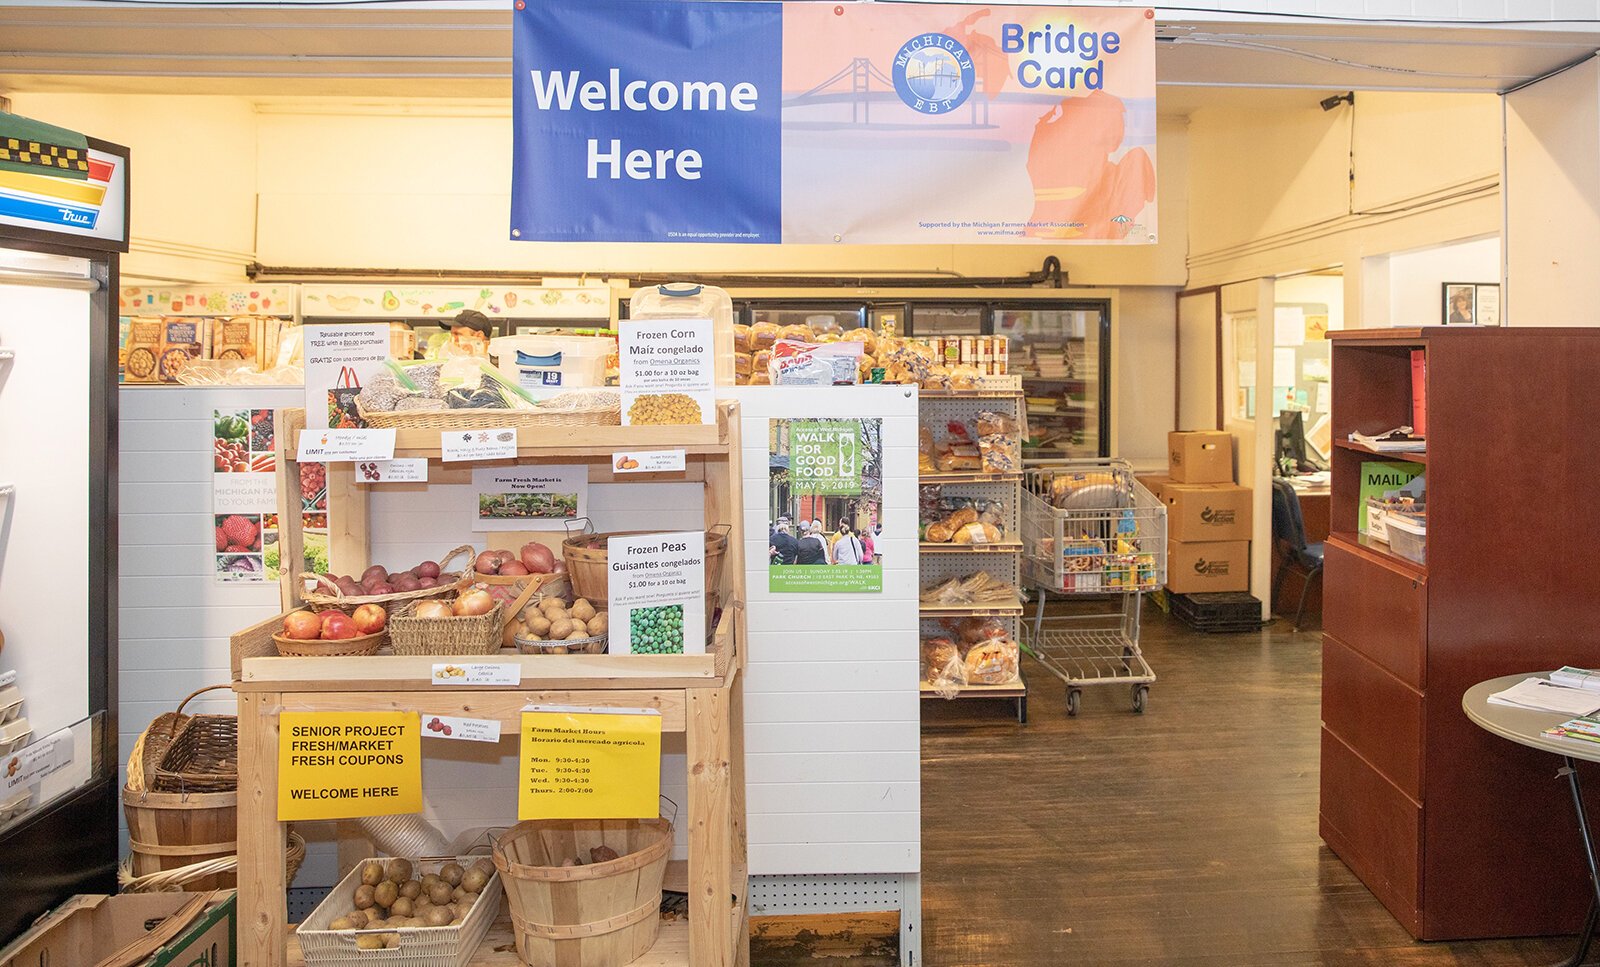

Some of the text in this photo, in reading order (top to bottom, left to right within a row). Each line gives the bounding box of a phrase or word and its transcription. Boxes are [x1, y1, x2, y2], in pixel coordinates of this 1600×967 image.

[1001, 23, 1121, 61] Bridge
[895, 34, 972, 71] MICHIGAN
[1017, 59, 1104, 91] Card
[531, 68, 758, 112] Welcome
[914, 99, 952, 112] EBT
[586, 138, 703, 180] Here
[58, 208, 91, 224] true
[918, 221, 952, 229] Supported
[952, 221, 960, 229] by
[977, 230, 1026, 238] www.mifma.org
[636, 329, 696, 340] Frozen Corn
[629, 344, 704, 356] Maíz congelado
[650, 358, 672, 366] Omena
[672, 358, 701, 366] Organics
[547, 372, 558, 380] 19
[634, 370, 653, 378] $1.00
[796, 432, 835, 442] WALK
[796, 445, 821, 454] FOR
[796, 456, 836, 465] GOOD
[796, 466, 833, 476] FOOD
[821, 482, 829, 490] 5,
[1368, 474, 1402, 486] MAIL
[215, 488, 260, 496] MICHIGAN
[218, 498, 230, 506] TO
[230, 498, 256, 506] YOUR
[627, 542, 687, 555] Frozen Peas
[612, 558, 701, 572] Guisantes congelados
[628, 580, 647, 589] $1.00
[292, 726, 406, 738] SENIOR PROJECT
[292, 740, 394, 752] FRESH/MARKET
[292, 754, 404, 766] FRESH COUPONS
[8, 774, 24, 788] LIMIT
[290, 787, 399, 800] WELCOME HERE
